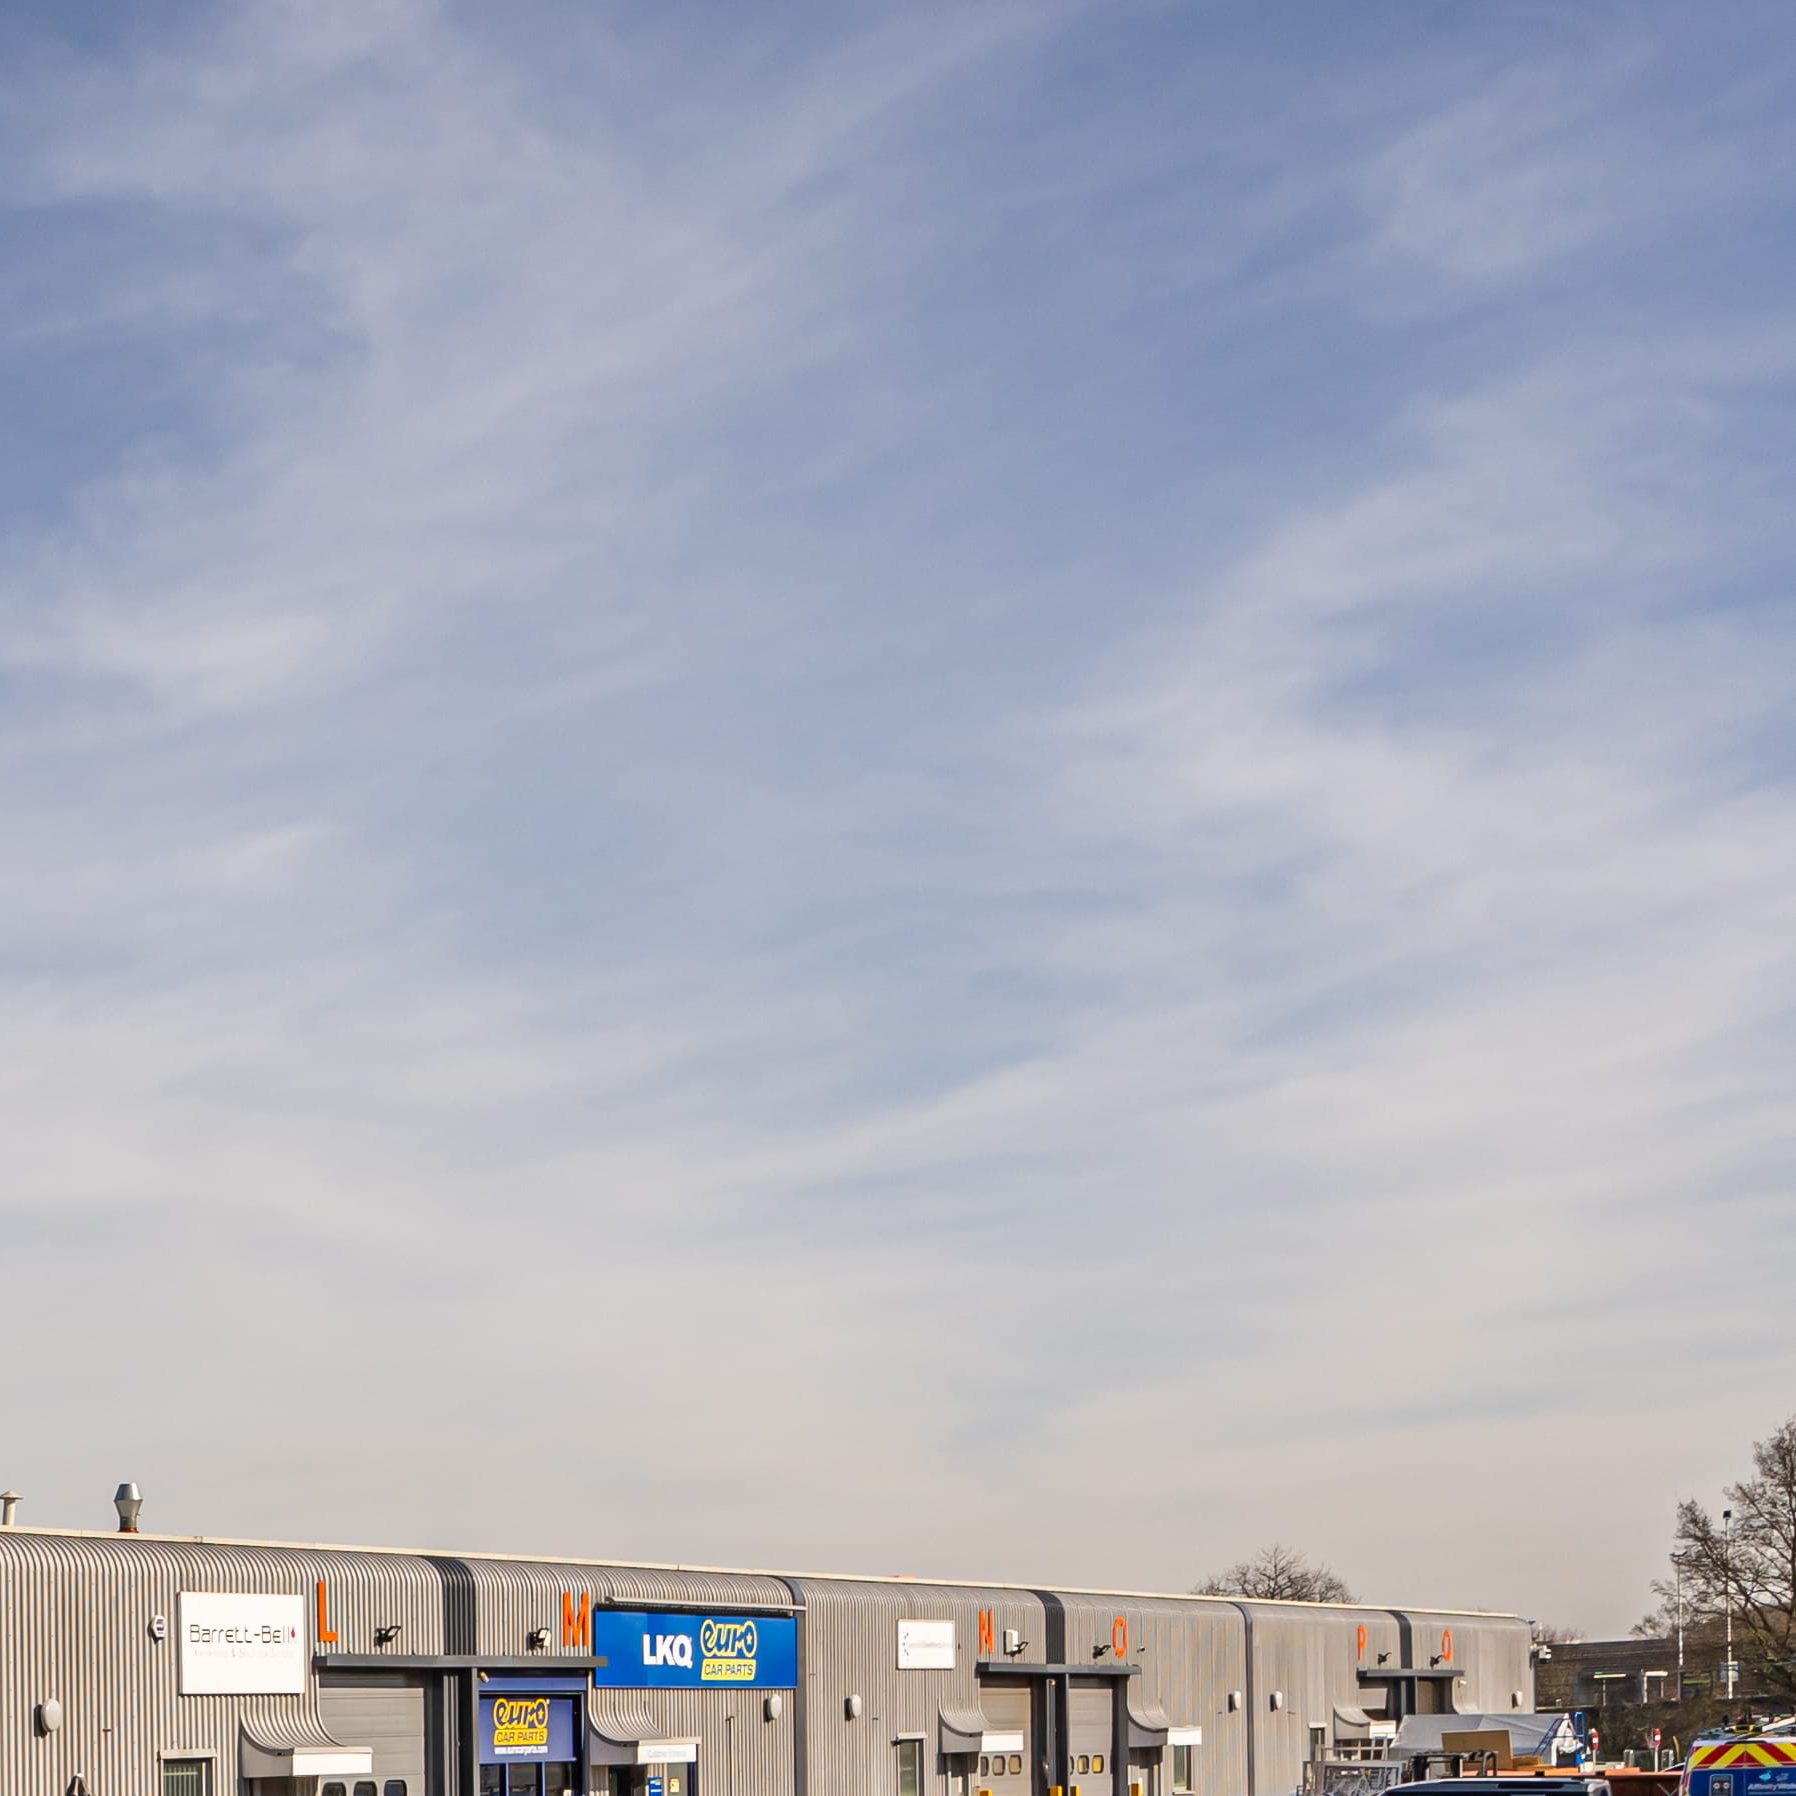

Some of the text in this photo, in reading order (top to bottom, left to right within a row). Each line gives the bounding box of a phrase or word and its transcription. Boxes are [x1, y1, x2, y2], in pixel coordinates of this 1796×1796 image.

[318, 1580, 339, 1642] L
[563, 1592, 590, 1647] M
[189, 1624, 290, 1644] Barrett-Bell
[979, 1609, 994, 1654] N
[1357, 1625, 1368, 1661] P
[642, 1633, 693, 1669] LKQ
[704, 1663, 754, 1676] CAR PARTS
[496, 1730, 545, 1743] CAR PARTS
